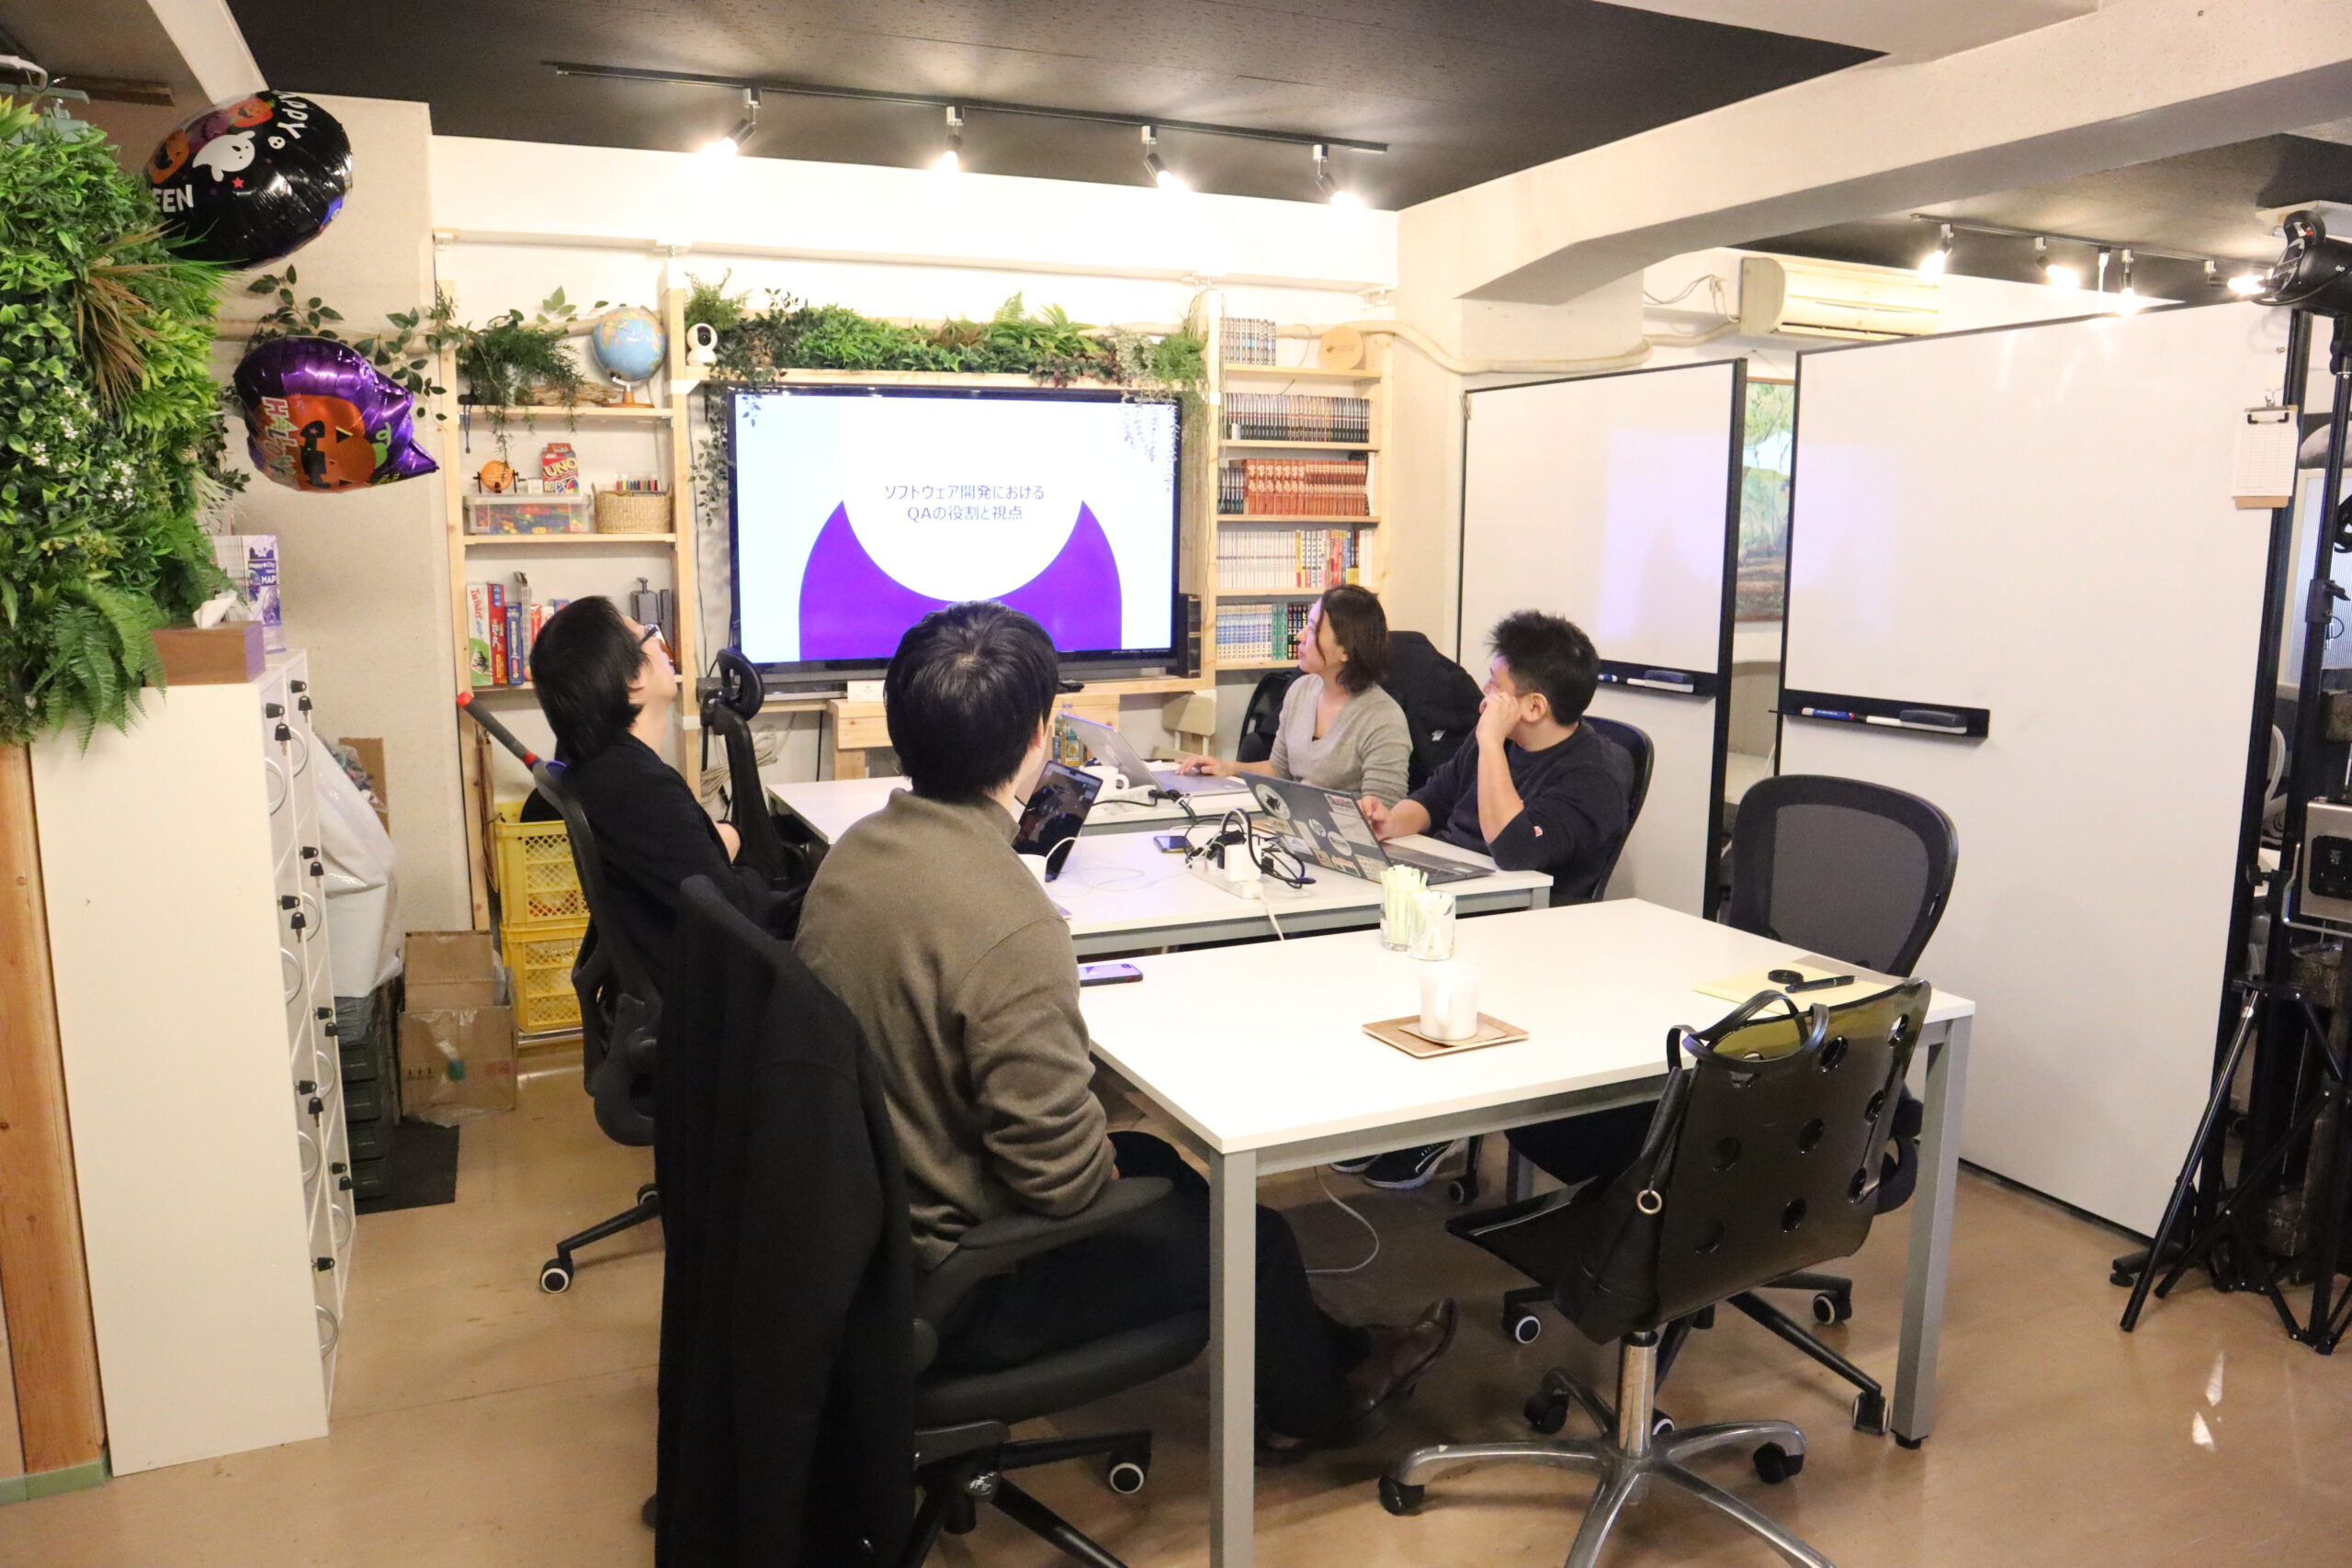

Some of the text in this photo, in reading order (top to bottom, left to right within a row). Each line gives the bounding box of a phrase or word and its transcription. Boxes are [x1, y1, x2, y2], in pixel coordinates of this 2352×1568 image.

[543, 457, 577, 477] UNO
[885, 484, 1045, 501] ソフトウェア開発における
[907, 505, 1023, 524] QAの役割と視点
[261, 574, 277, 585] MAP
